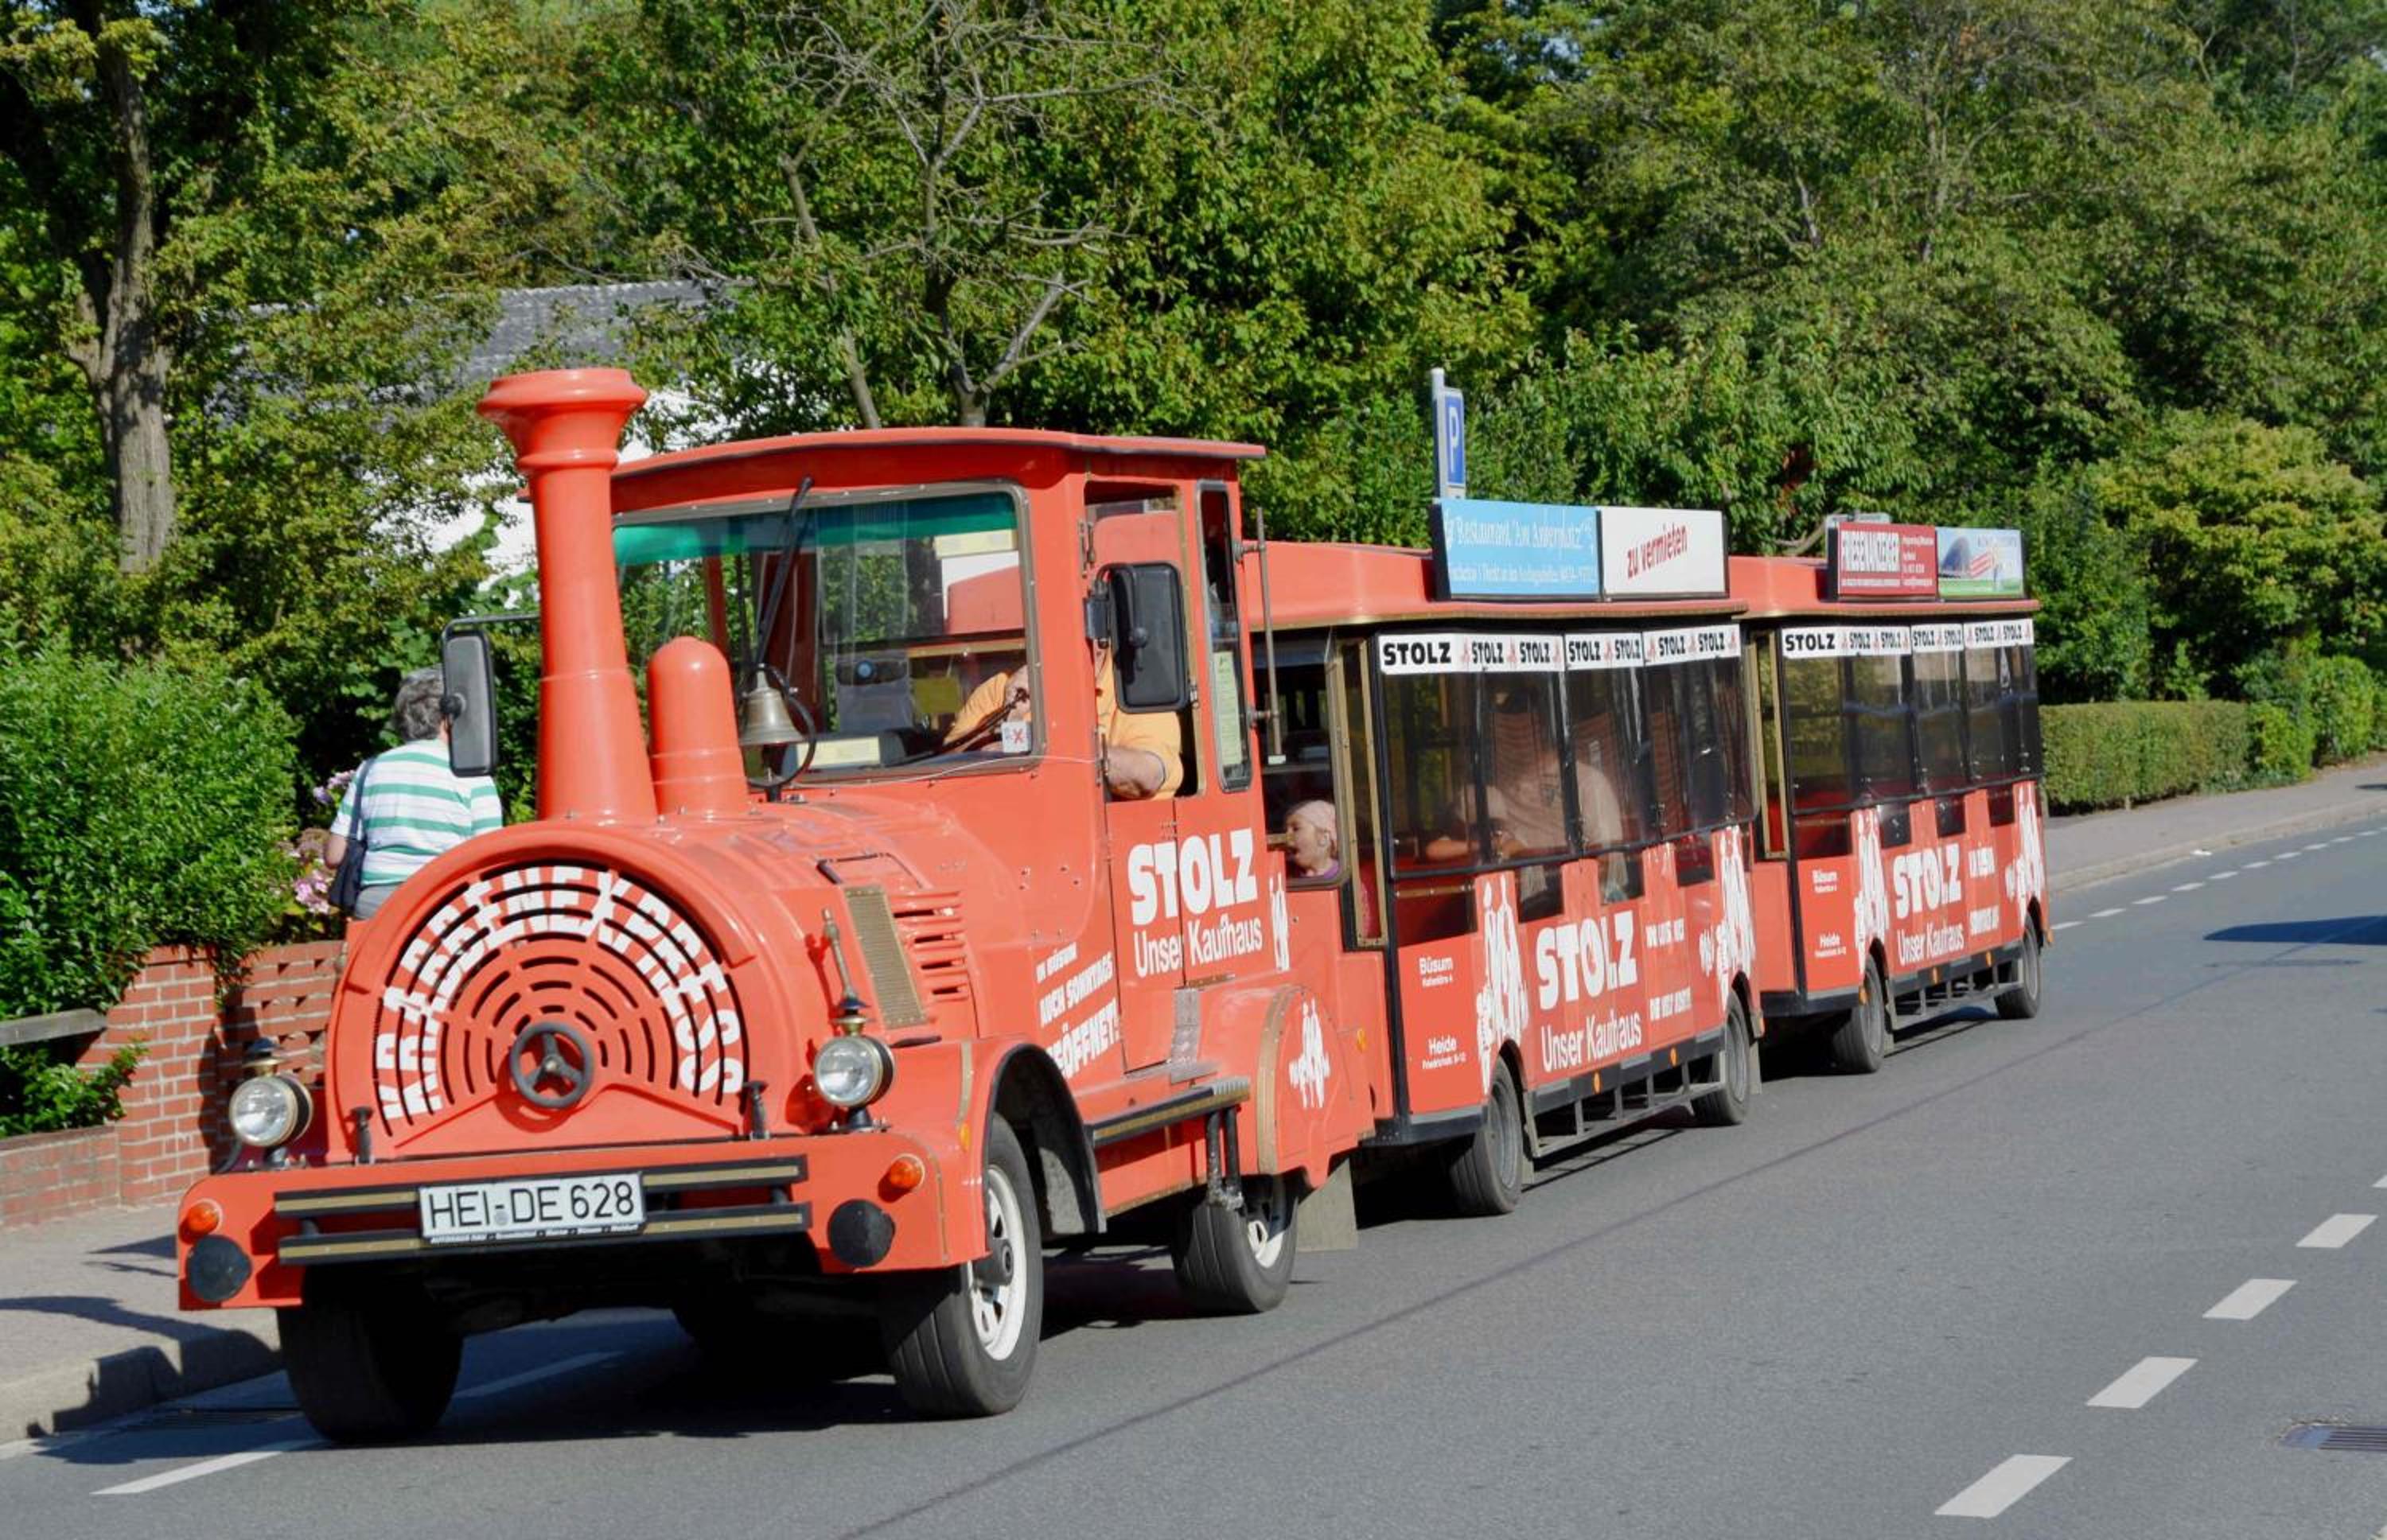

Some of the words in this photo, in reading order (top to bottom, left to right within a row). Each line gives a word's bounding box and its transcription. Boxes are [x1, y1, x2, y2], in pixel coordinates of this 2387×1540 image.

[1449, 406, 1462, 474] P
[1626, 546, 1638, 578] zu
[1641, 522, 1688, 571] vermieten
[1383, 641, 1451, 665] STOLZ
[1472, 642, 1504, 664] STOLZ
[1520, 642, 1550, 663] STOLZ
[1568, 641, 1601, 662] STOLZ
[1614, 640, 1641, 659] STOLZ
[1659, 636, 1685, 656] STOLZ
[1699, 632, 1725, 652] STOLZ
[1785, 633, 1836, 651] STOLZ
[1850, 633, 1871, 648] STOLZ
[1881, 632, 1901, 648] STOLZ
[1914, 631, 1934, 647] STOLZ
[1945, 630, 1961, 645] STOLZ
[1975, 627, 1994, 642] STOLZ
[2003, 624, 2023, 640] STOLZ
[1127, 827, 1258, 926] STOLZ
[1893, 842, 1962, 919] STOLZ
[1134, 931, 1184, 978] Unser
[1187, 913, 1264, 966] Kaufhaus
[1419, 957, 1454, 975] Büsum
[1536, 910, 1637, 1010] STOLZ
[1897, 929, 1926, 966] Unser
[1926, 920, 1965, 959] Kaufhaus
[1066, 951, 1113, 1009] SONNTAGS
[1428, 1036, 1458, 1056] Heide
[1540, 1024, 1584, 1072] Unser
[1586, 1009, 1642, 1060] Kaufhaus
[570, 1181, 634, 1219] 628
